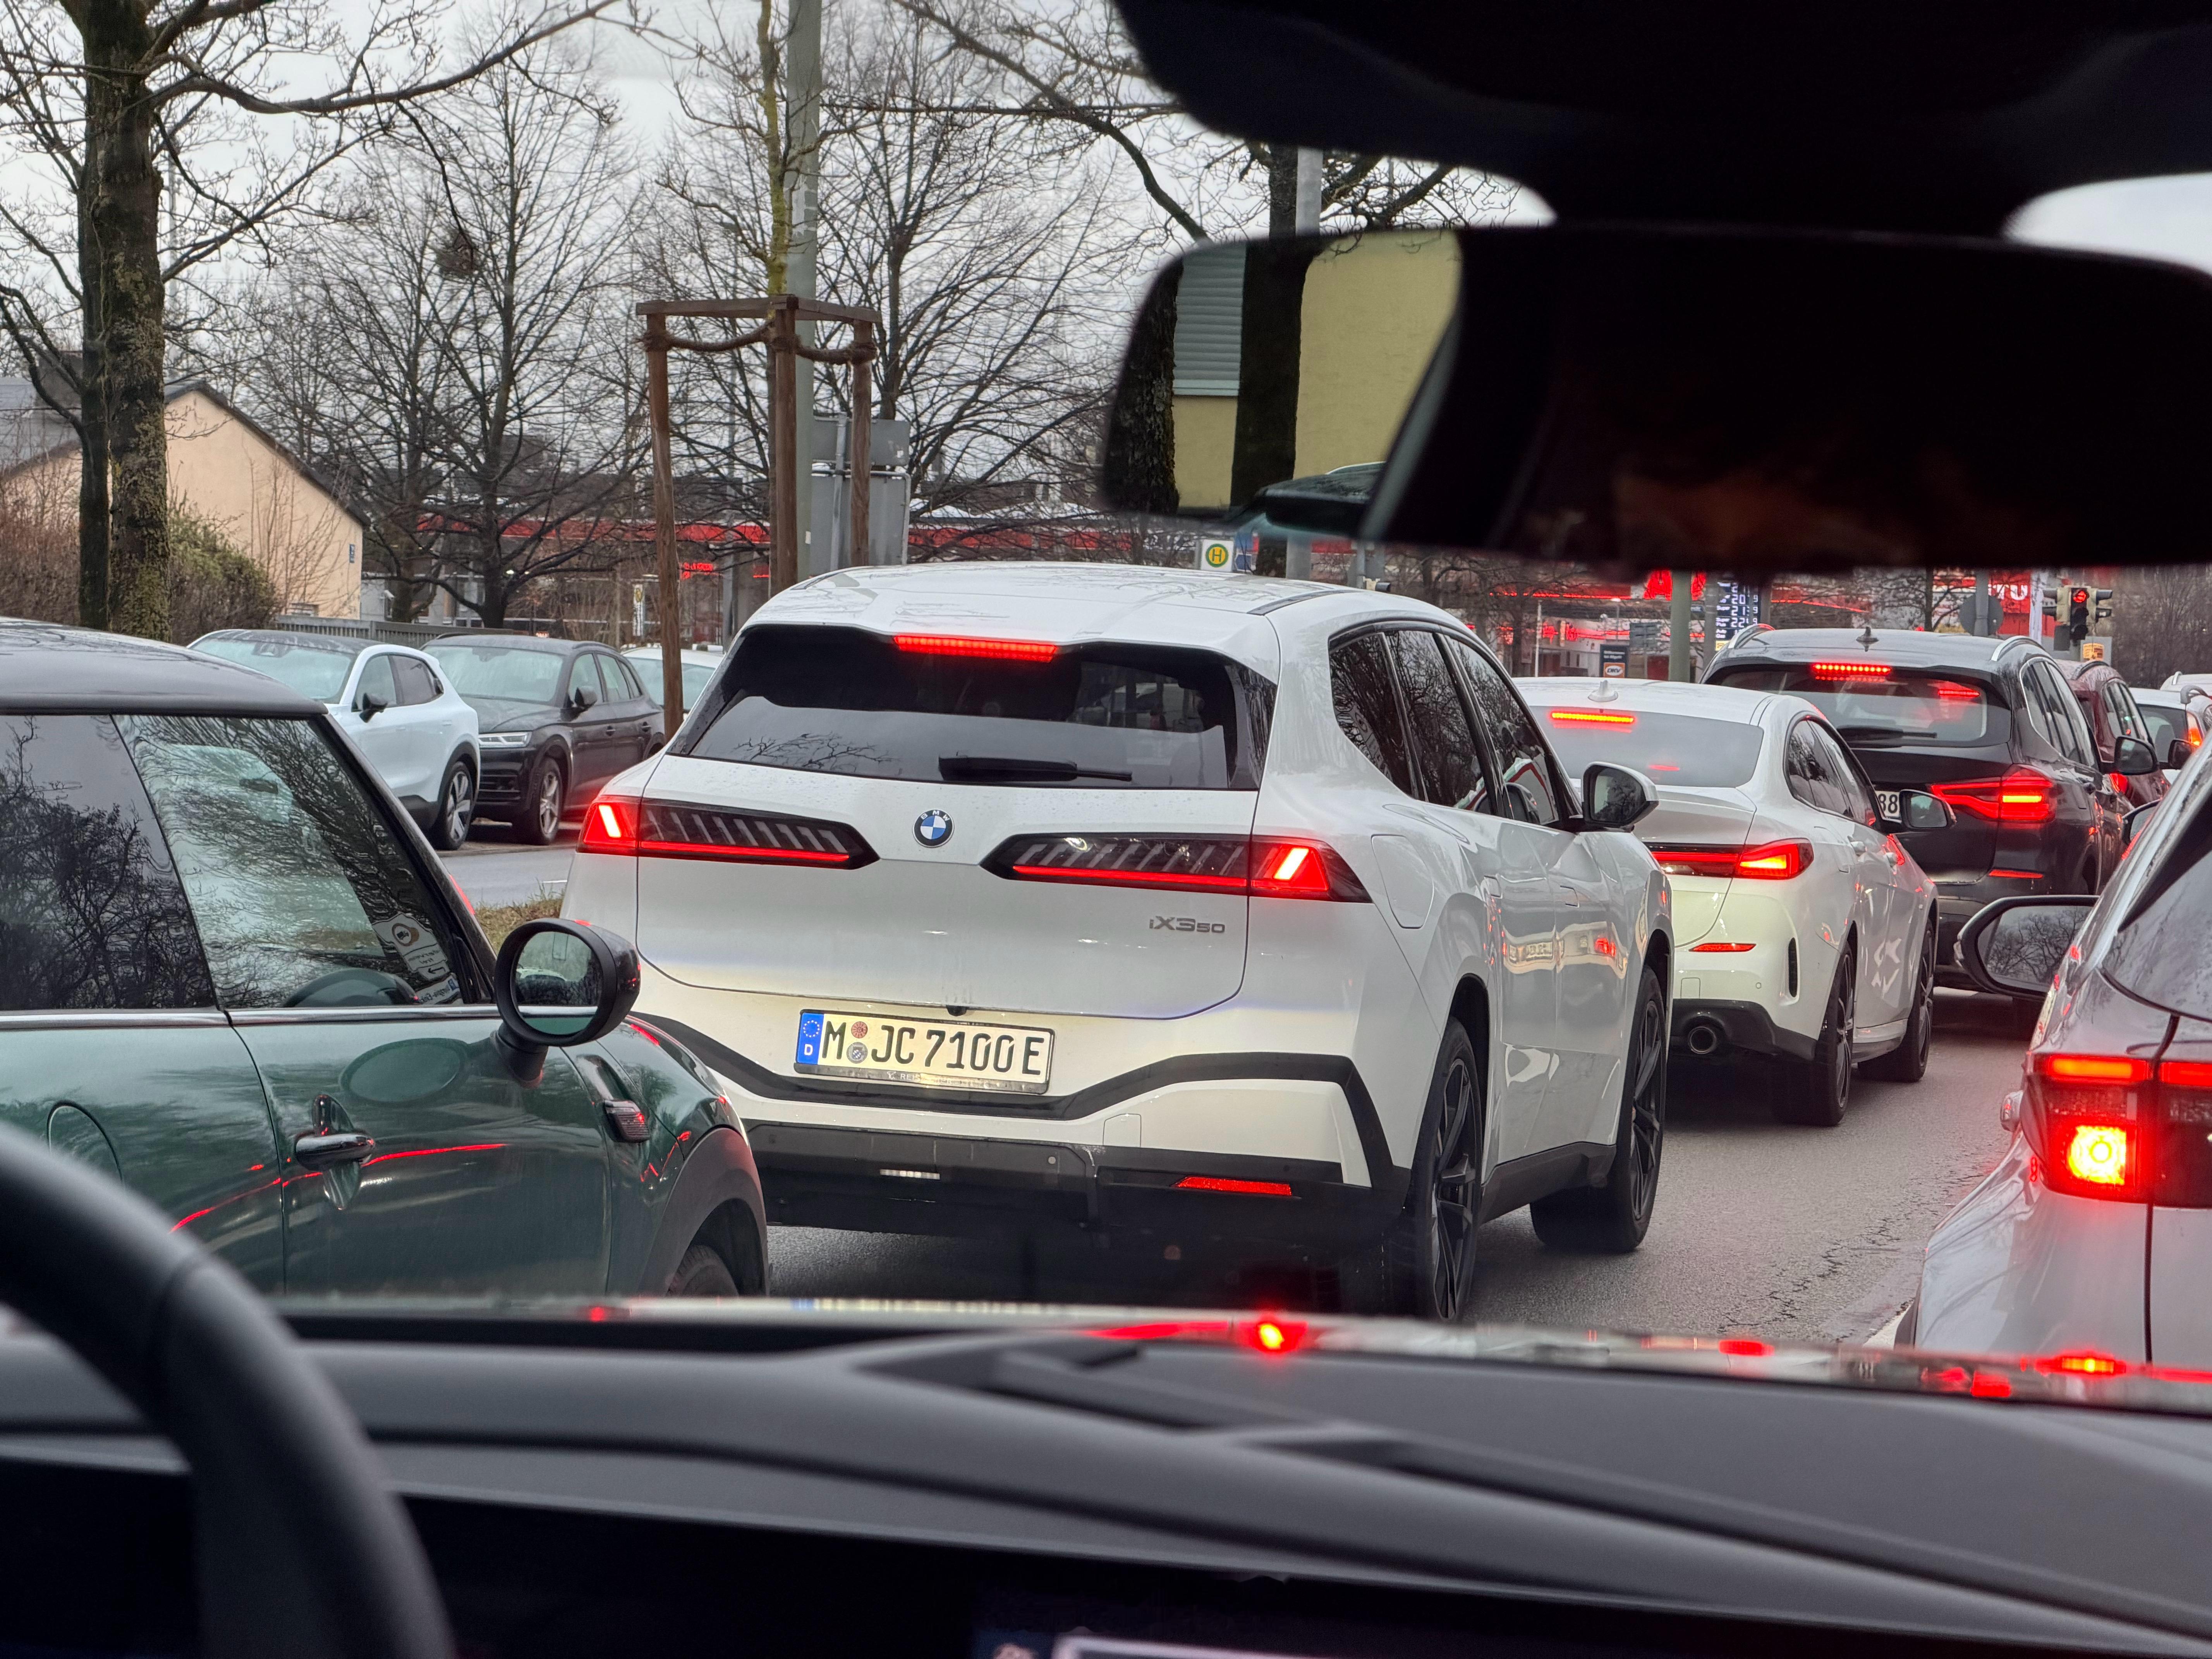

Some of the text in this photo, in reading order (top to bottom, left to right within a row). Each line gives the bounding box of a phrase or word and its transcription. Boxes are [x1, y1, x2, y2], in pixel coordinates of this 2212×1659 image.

[920, 810, 950, 821] BMW
[822, 1020, 847, 1060] M
[871, 1025, 916, 1064] JC
[804, 1044, 813, 1056] D
